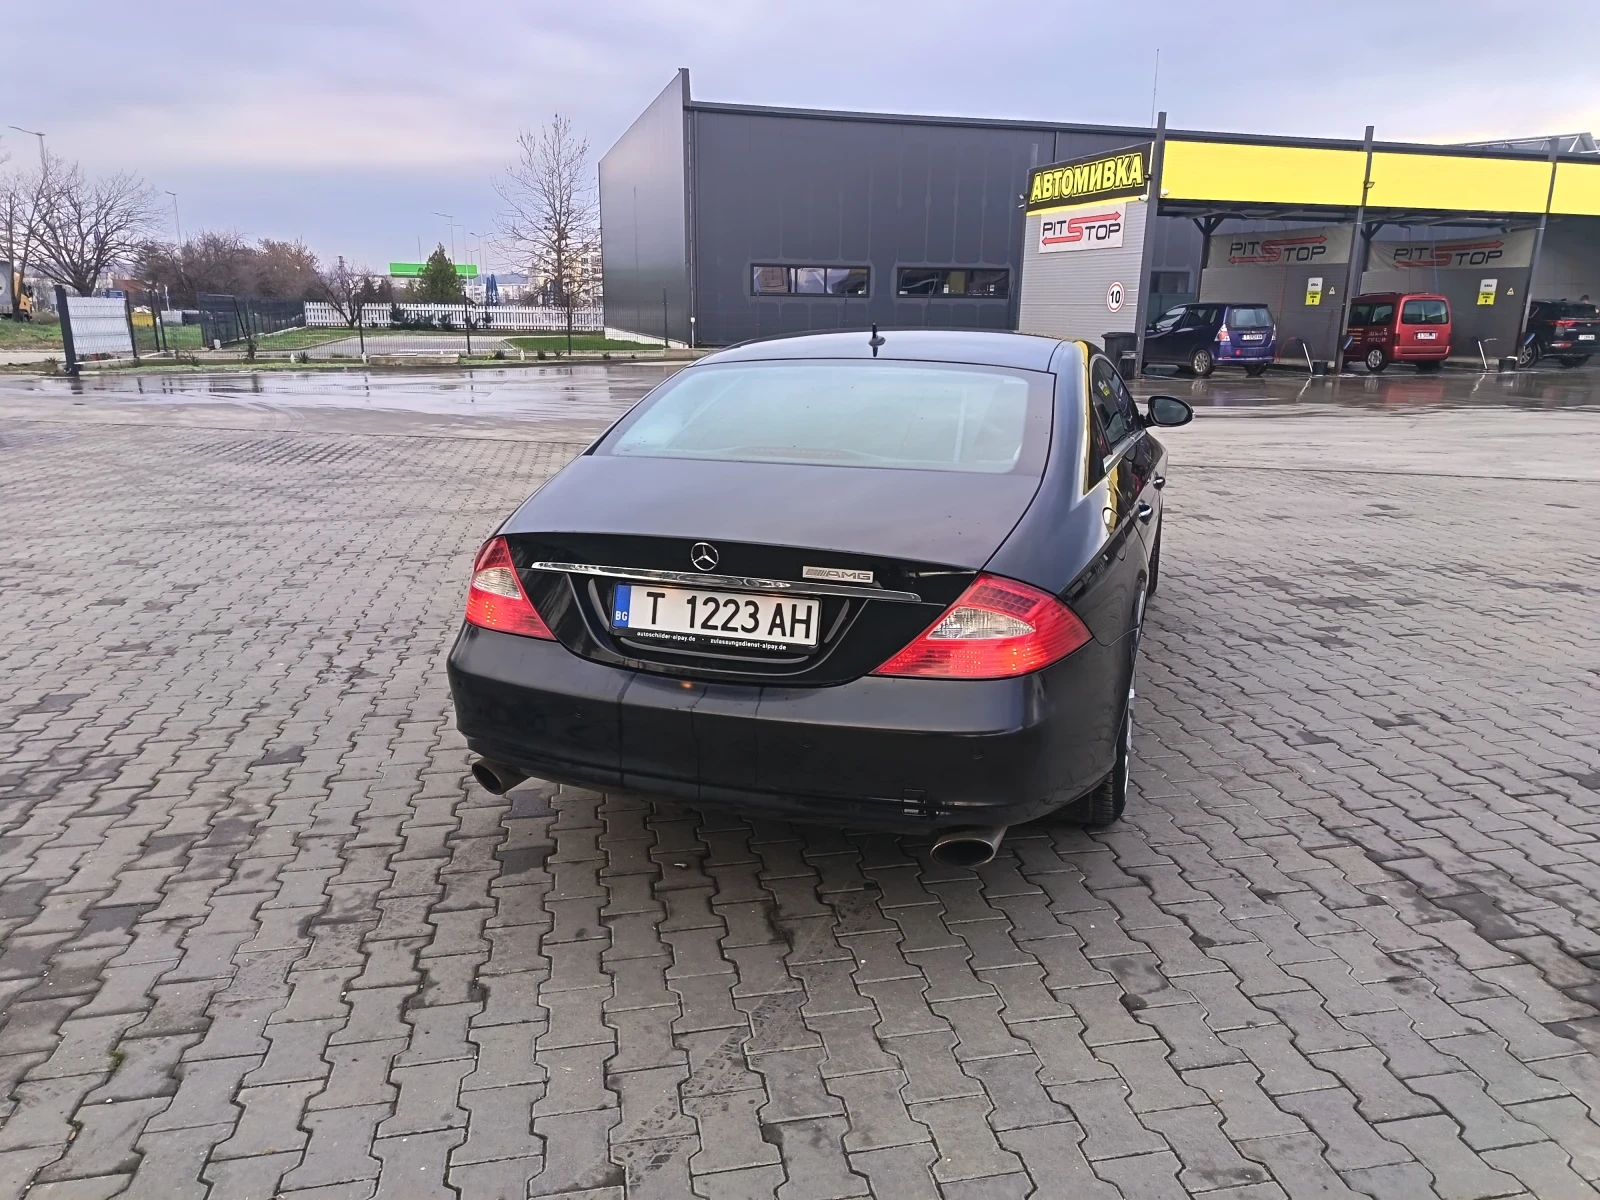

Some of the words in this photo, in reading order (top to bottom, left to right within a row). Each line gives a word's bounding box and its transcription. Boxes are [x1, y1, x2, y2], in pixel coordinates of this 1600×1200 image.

[1030, 153, 1144, 203] АВТОМИВКА
[1042, 220, 1067, 237] PIT
[1230, 242, 1260, 256] PIT
[1394, 248, 1429, 260] PIT
[1110, 290, 1121, 304] 10
[826, 570, 871, 581] AMG
[615, 611, 628, 621] BG
[646, 591, 666, 625] T
[686, 595, 760, 634] 1223
[767, 603, 813, 639] AH
[636, 631, 696, 642] autoschilder-alpay.de
[710, 638, 787, 651] zulassungsdienst-alpay.de
